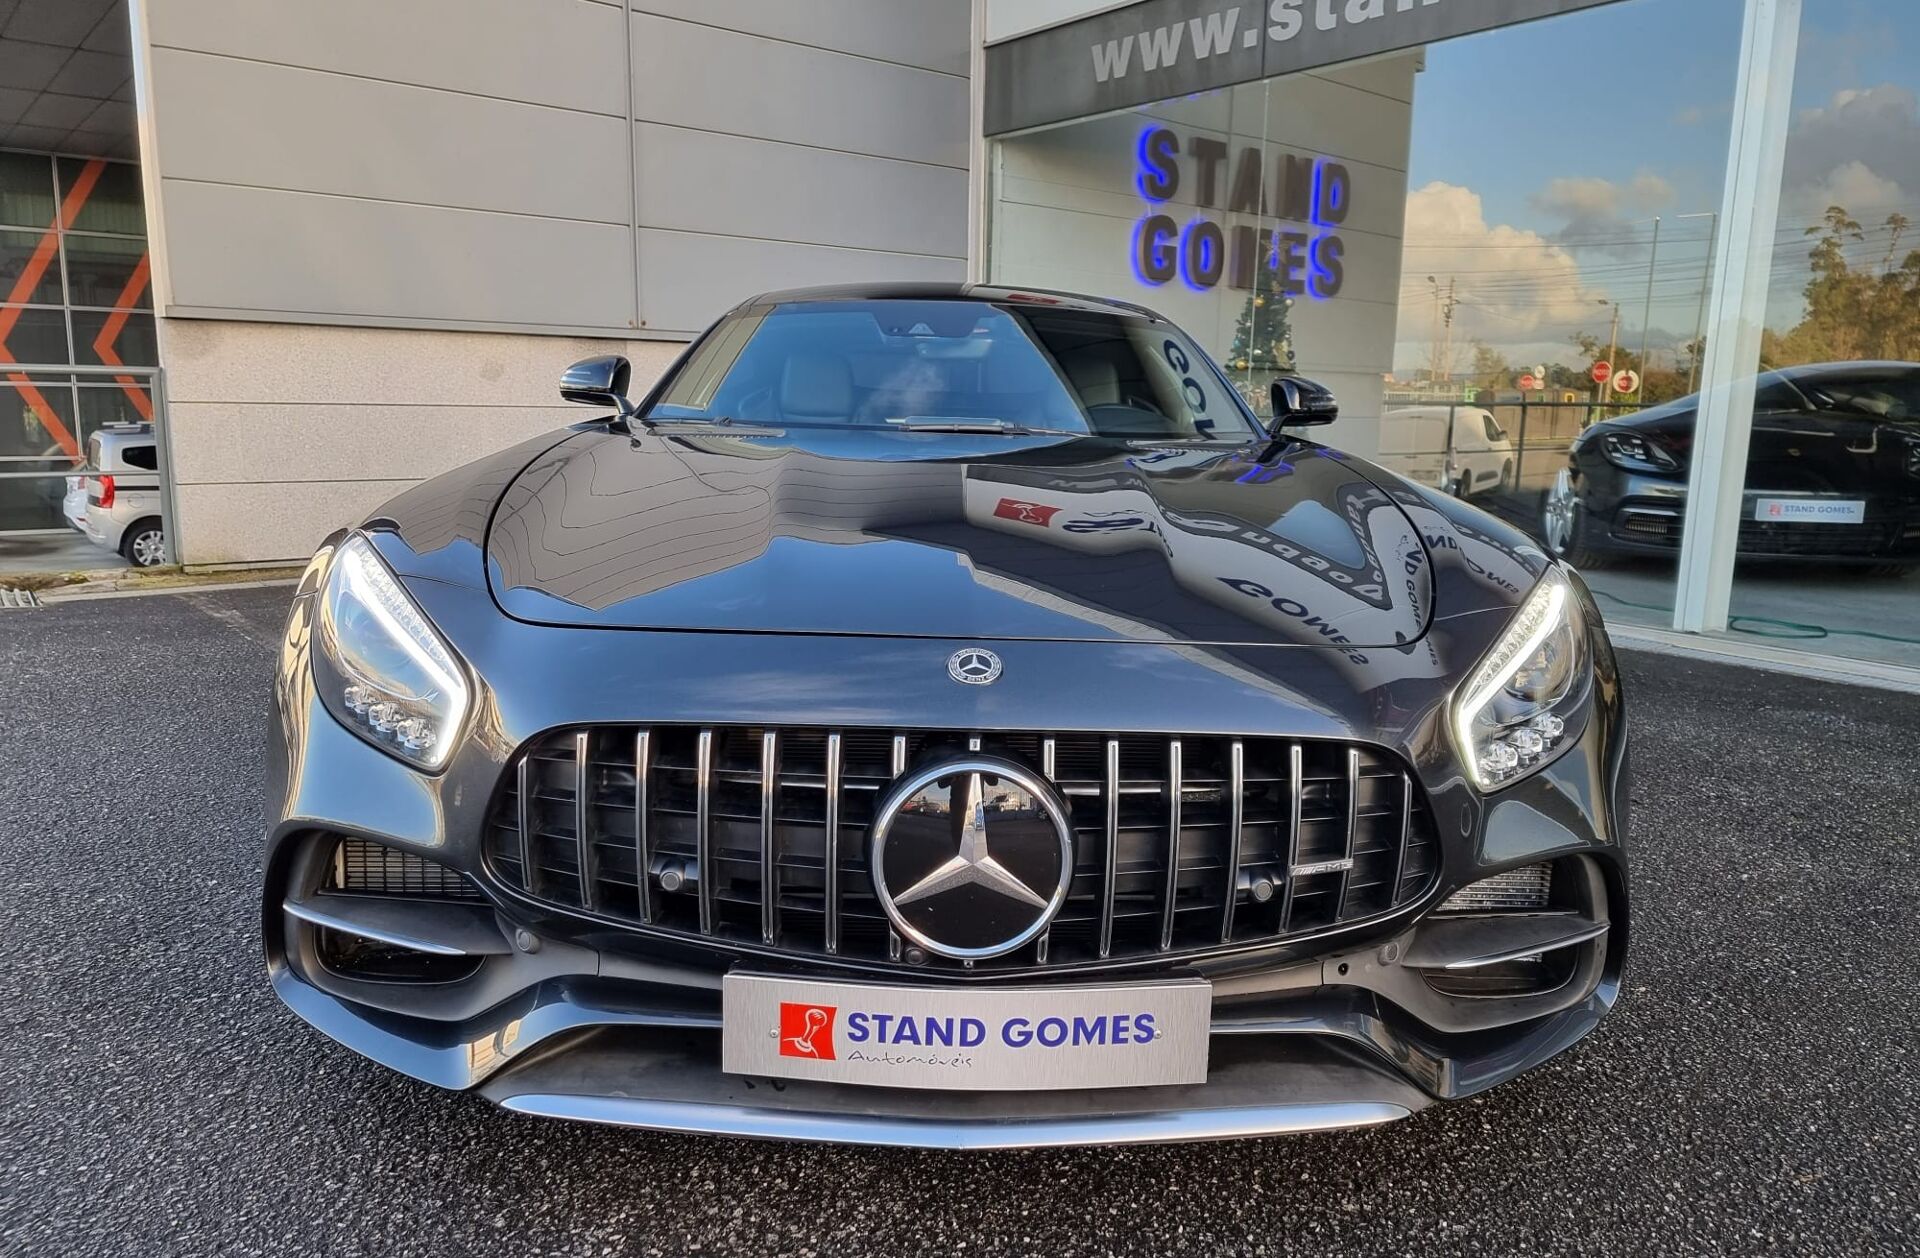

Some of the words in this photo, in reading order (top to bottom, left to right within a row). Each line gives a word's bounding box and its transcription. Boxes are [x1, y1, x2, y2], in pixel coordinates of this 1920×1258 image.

[1138, 127, 1350, 227] STAND
[1133, 213, 1345, 298] GOMES
[1784, 505, 1815, 513] STAND
[1817, 506, 1851, 514] GOMES
[847, 1012, 986, 1047] STAND
[1001, 1013, 1156, 1048] GOMES
[847, 1050, 973, 1068] Automóveis
